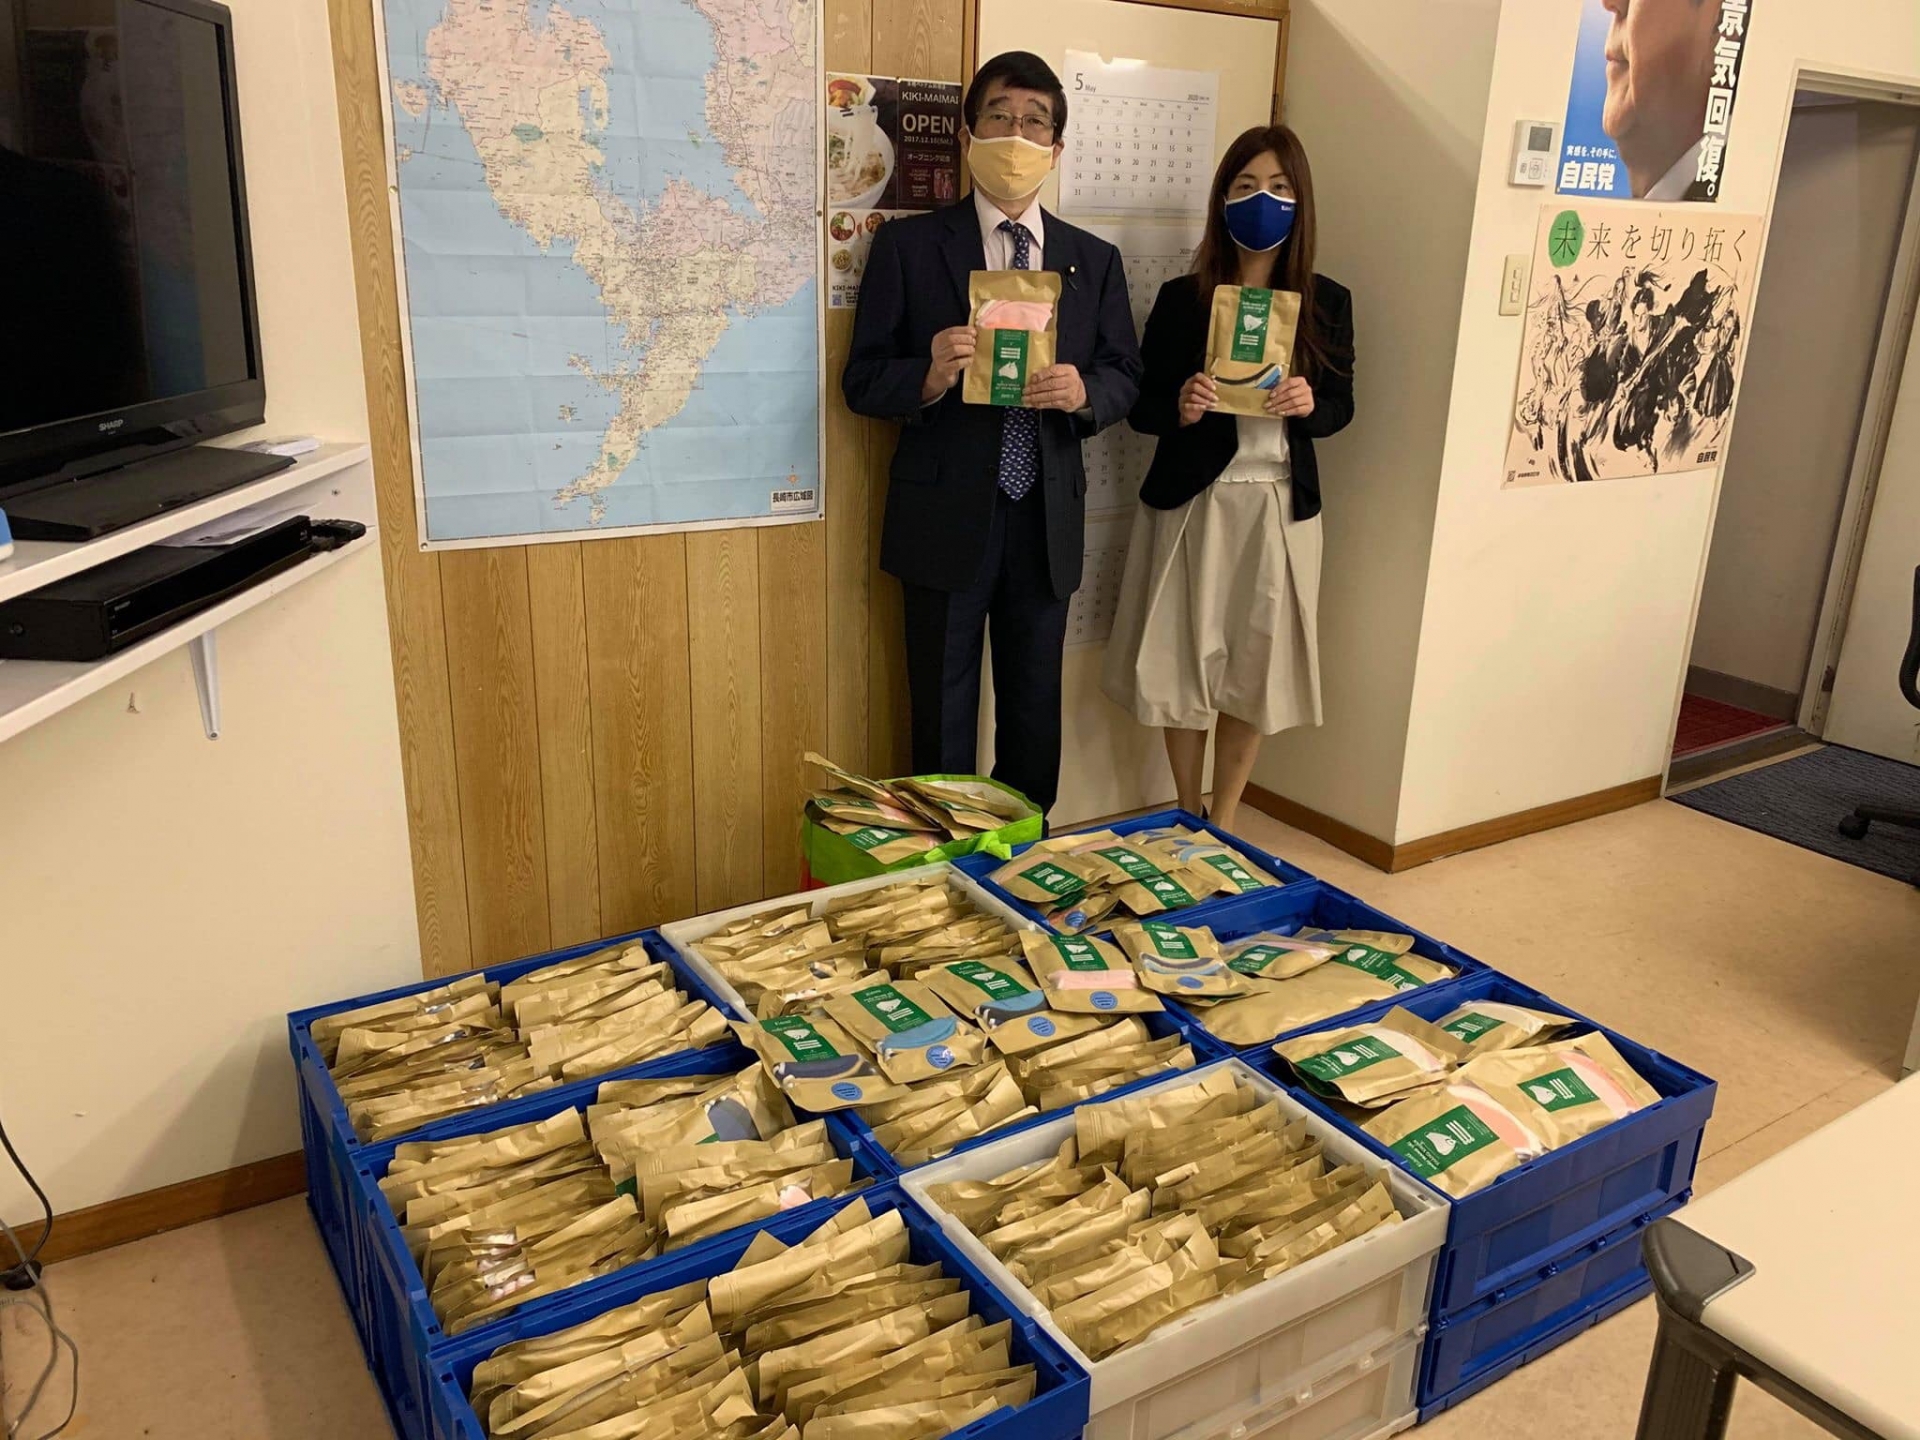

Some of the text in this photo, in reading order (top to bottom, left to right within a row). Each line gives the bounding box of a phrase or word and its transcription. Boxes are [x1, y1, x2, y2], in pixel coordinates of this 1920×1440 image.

[1075, 73, 1096, 93] 5 May
[902, 91, 959, 104] KIKI-MAIMAI
[1696, 0, 1748, 197] 景気回復。
[903, 113, 955, 135] OPEN
[1560, 161, 1615, 191] 自民党
[1552, 221, 1747, 262] 未来を切り拓く
[99, 419, 123, 431] SHARP
